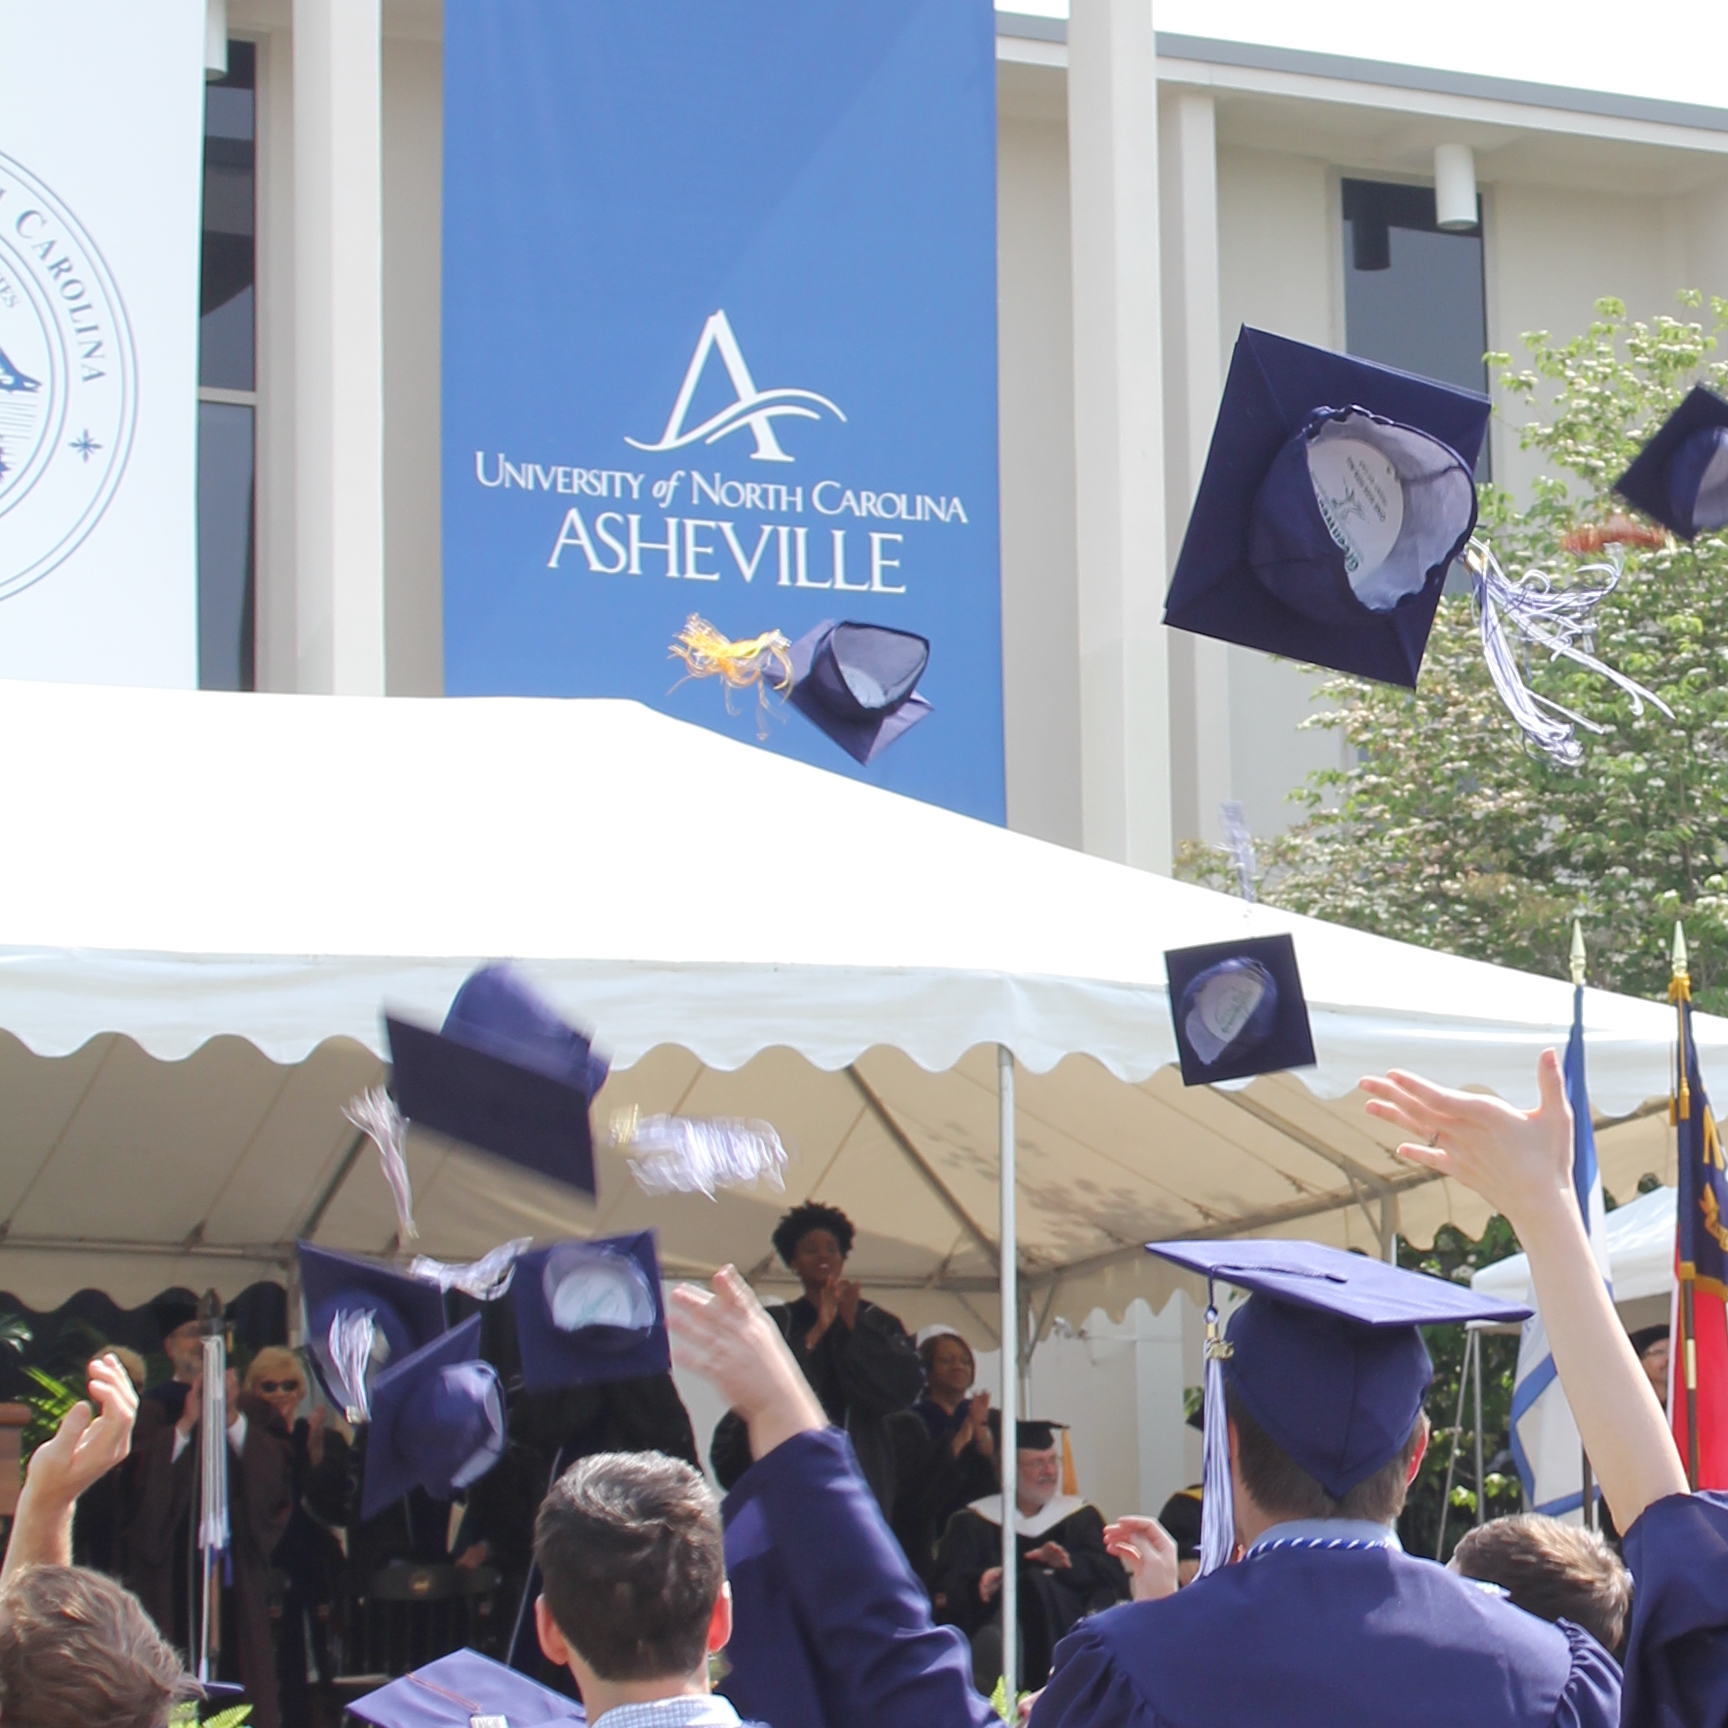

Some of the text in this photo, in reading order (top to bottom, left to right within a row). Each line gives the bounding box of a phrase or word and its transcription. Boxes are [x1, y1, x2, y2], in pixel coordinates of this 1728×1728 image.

[15, 209, 106, 383] CAROLINA
[475, 450, 969, 524] UNIVERSITY of NORTH CAROLINA
[546, 507, 907, 594] ASHEVILLE
